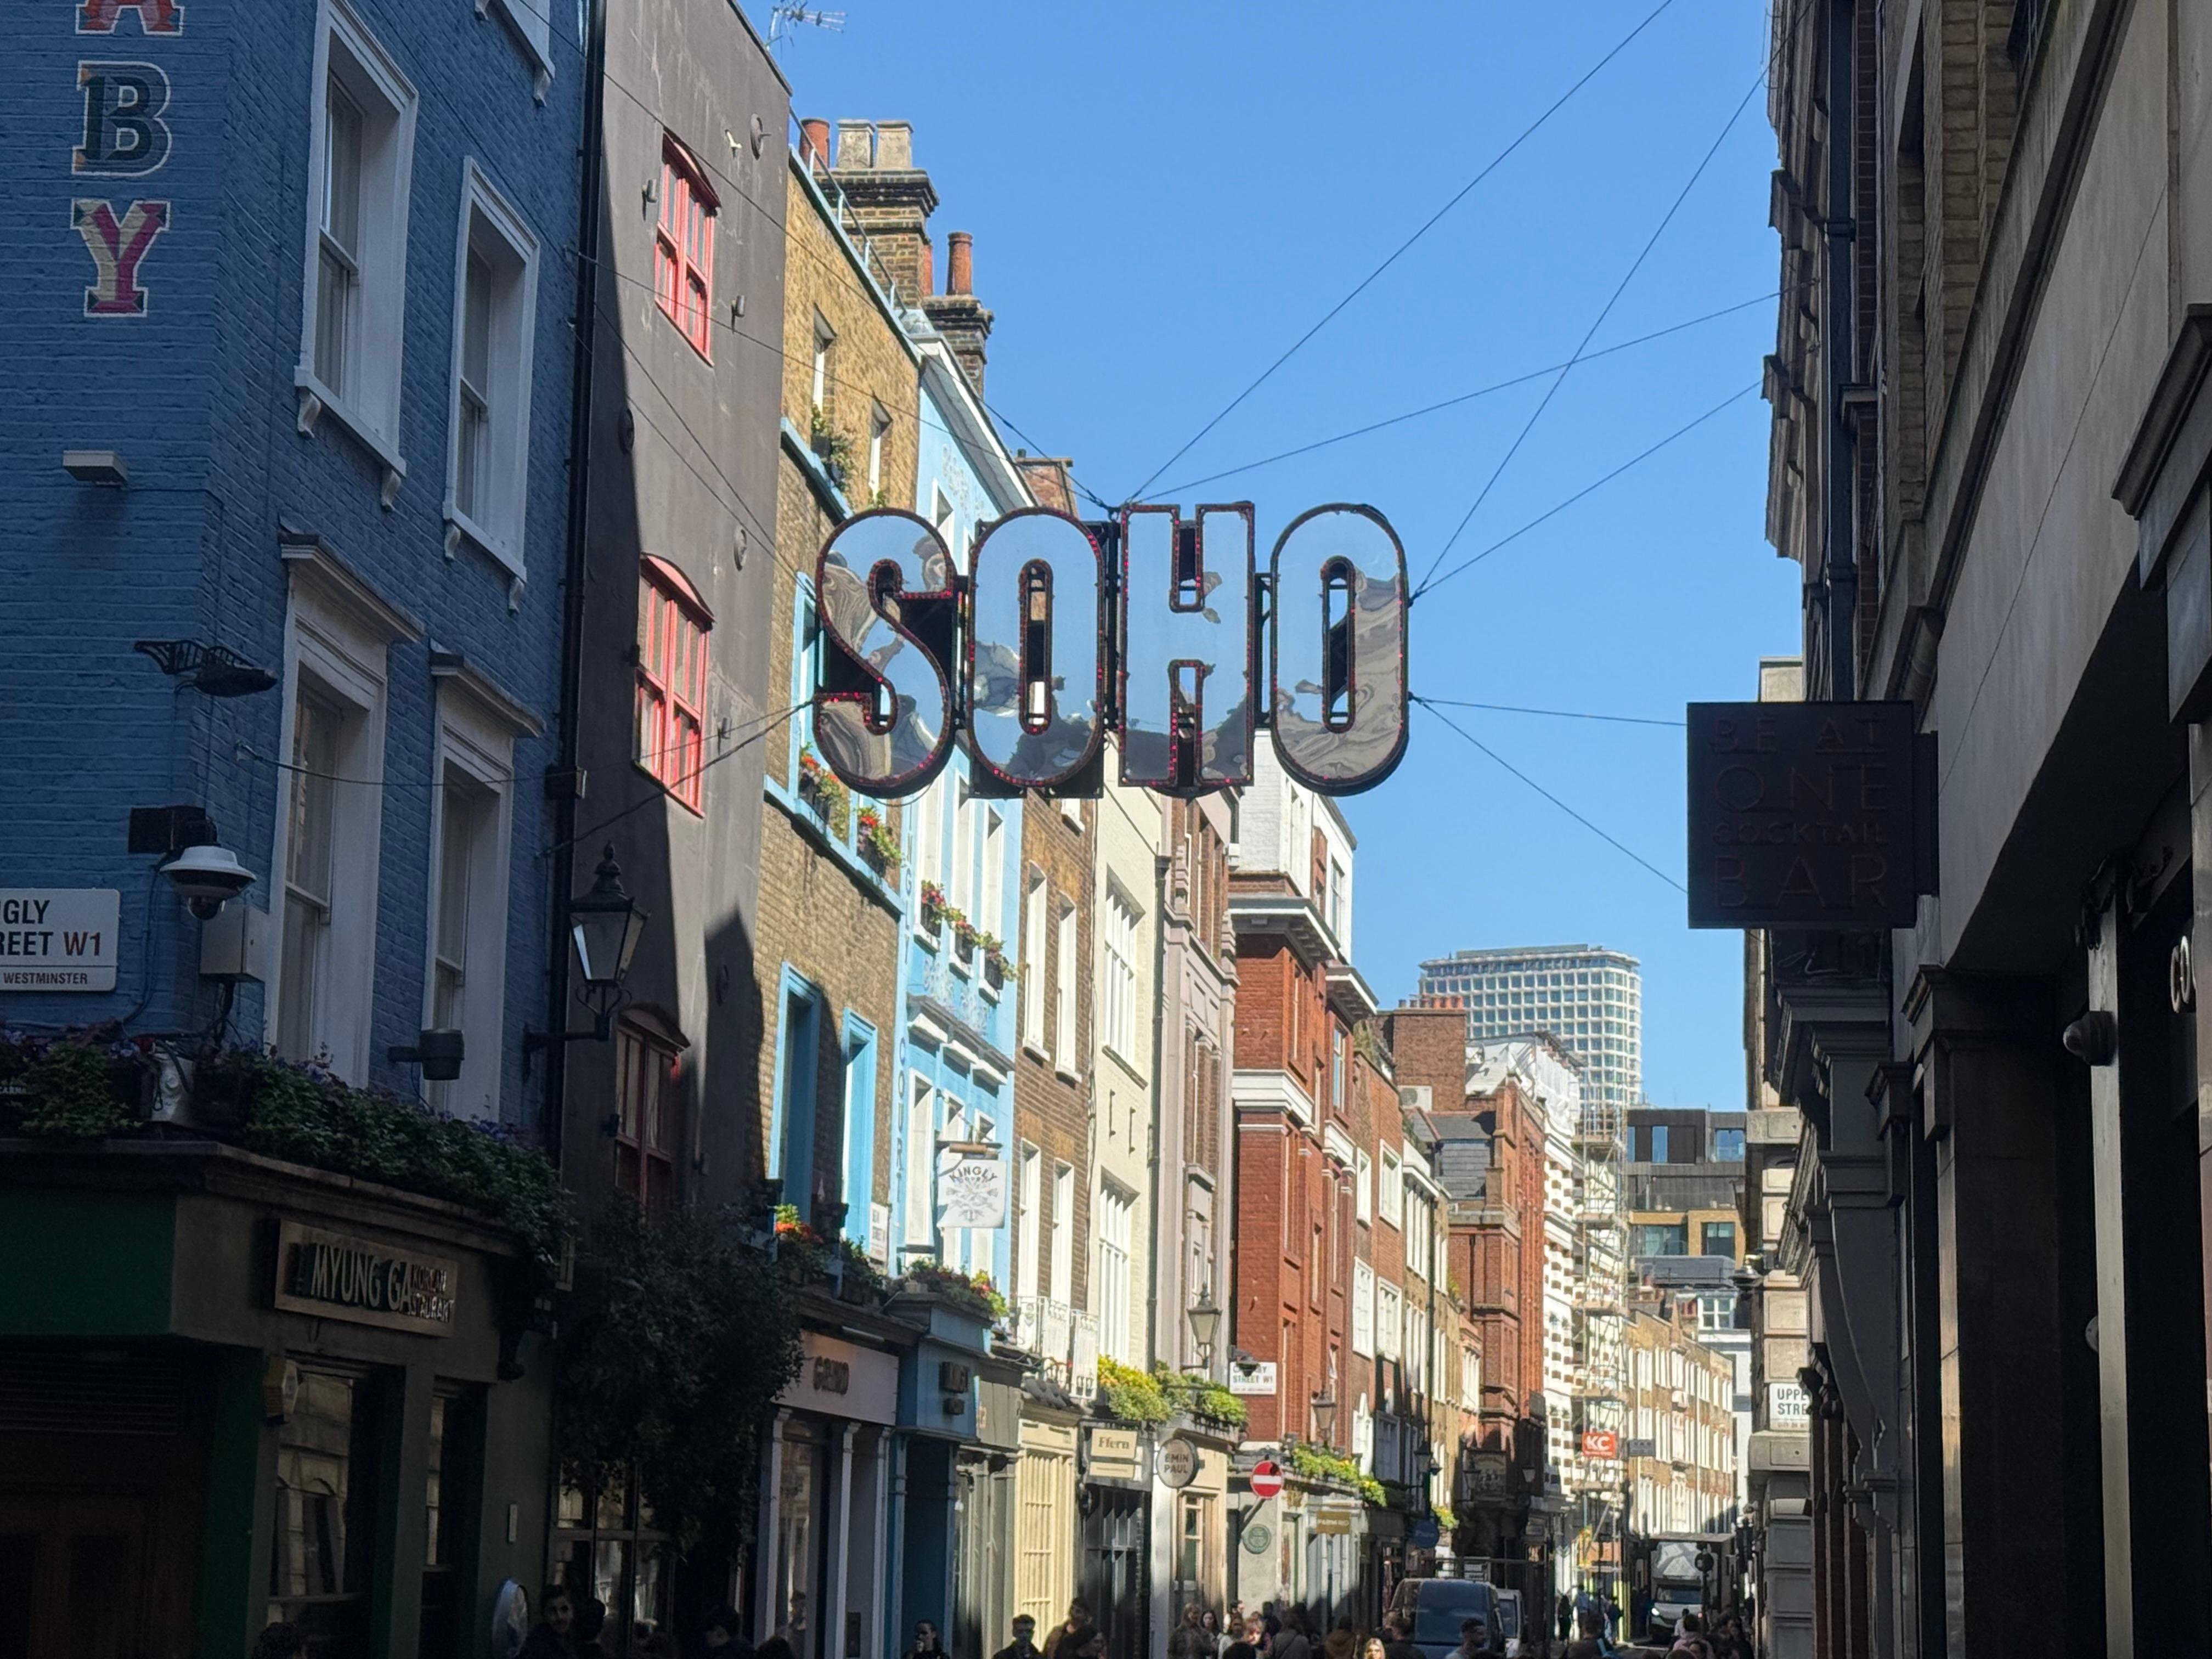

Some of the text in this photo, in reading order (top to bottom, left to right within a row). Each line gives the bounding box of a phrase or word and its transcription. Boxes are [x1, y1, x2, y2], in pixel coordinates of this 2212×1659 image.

[814, 501, 1410, 797] SOHO
[1714, 764, 1887, 811] ONE
[1713, 822, 1888, 845] COCKTAIL
[1714, 854, 1887, 909] BAR
[0, 899, 50, 924] GLY
[63, 932, 100, 956] W1
[3, 972, 88, 984] WESTMINSTER
[949, 1166, 997, 1183] KINGLY
[311, 1244, 381, 1307] MYUNG
[387, 1260, 413, 1312] GA
[407, 1292, 455, 1323] STAURANT
[1778, 1389, 1807, 1401] UPP
[1778, 1403, 1807, 1415] STRE
[1586, 1435, 1611, 1451] KC
